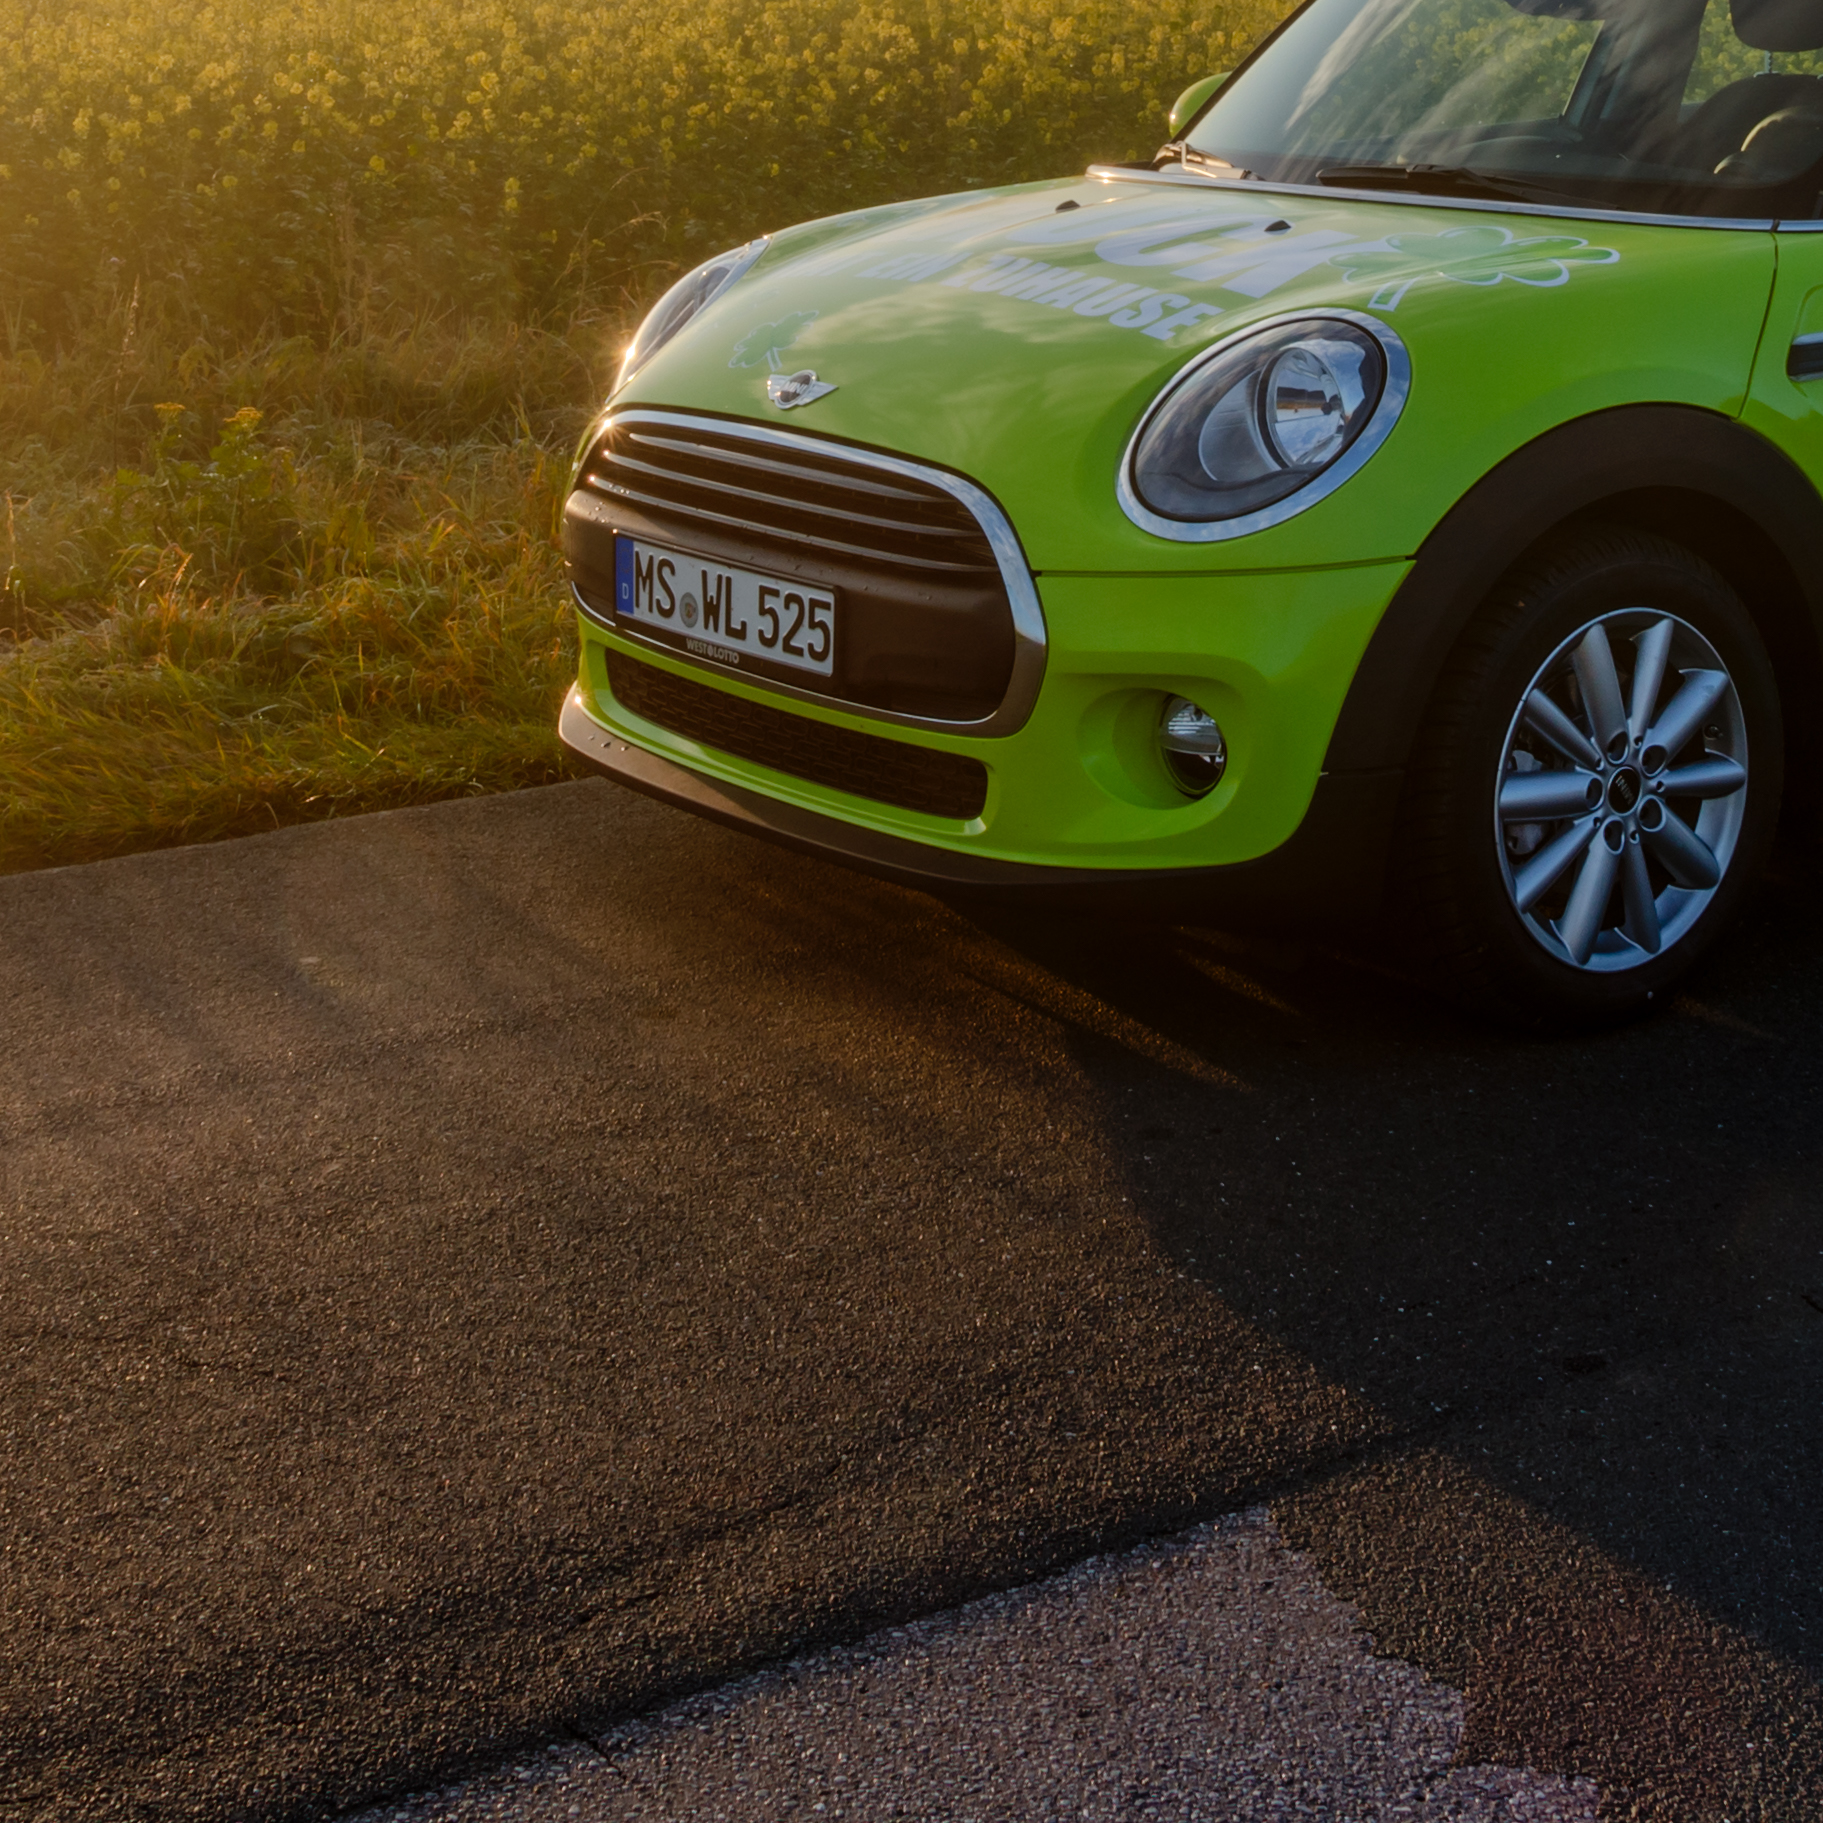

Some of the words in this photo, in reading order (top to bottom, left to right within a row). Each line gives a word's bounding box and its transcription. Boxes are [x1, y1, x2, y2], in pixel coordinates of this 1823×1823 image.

[941, 253, 1225, 341] ZUHAUSE
[622, 582, 629, 600] D
[634, 548, 676, 619] MS
[701, 569, 747, 641] WL
[758, 584, 832, 662] 525
